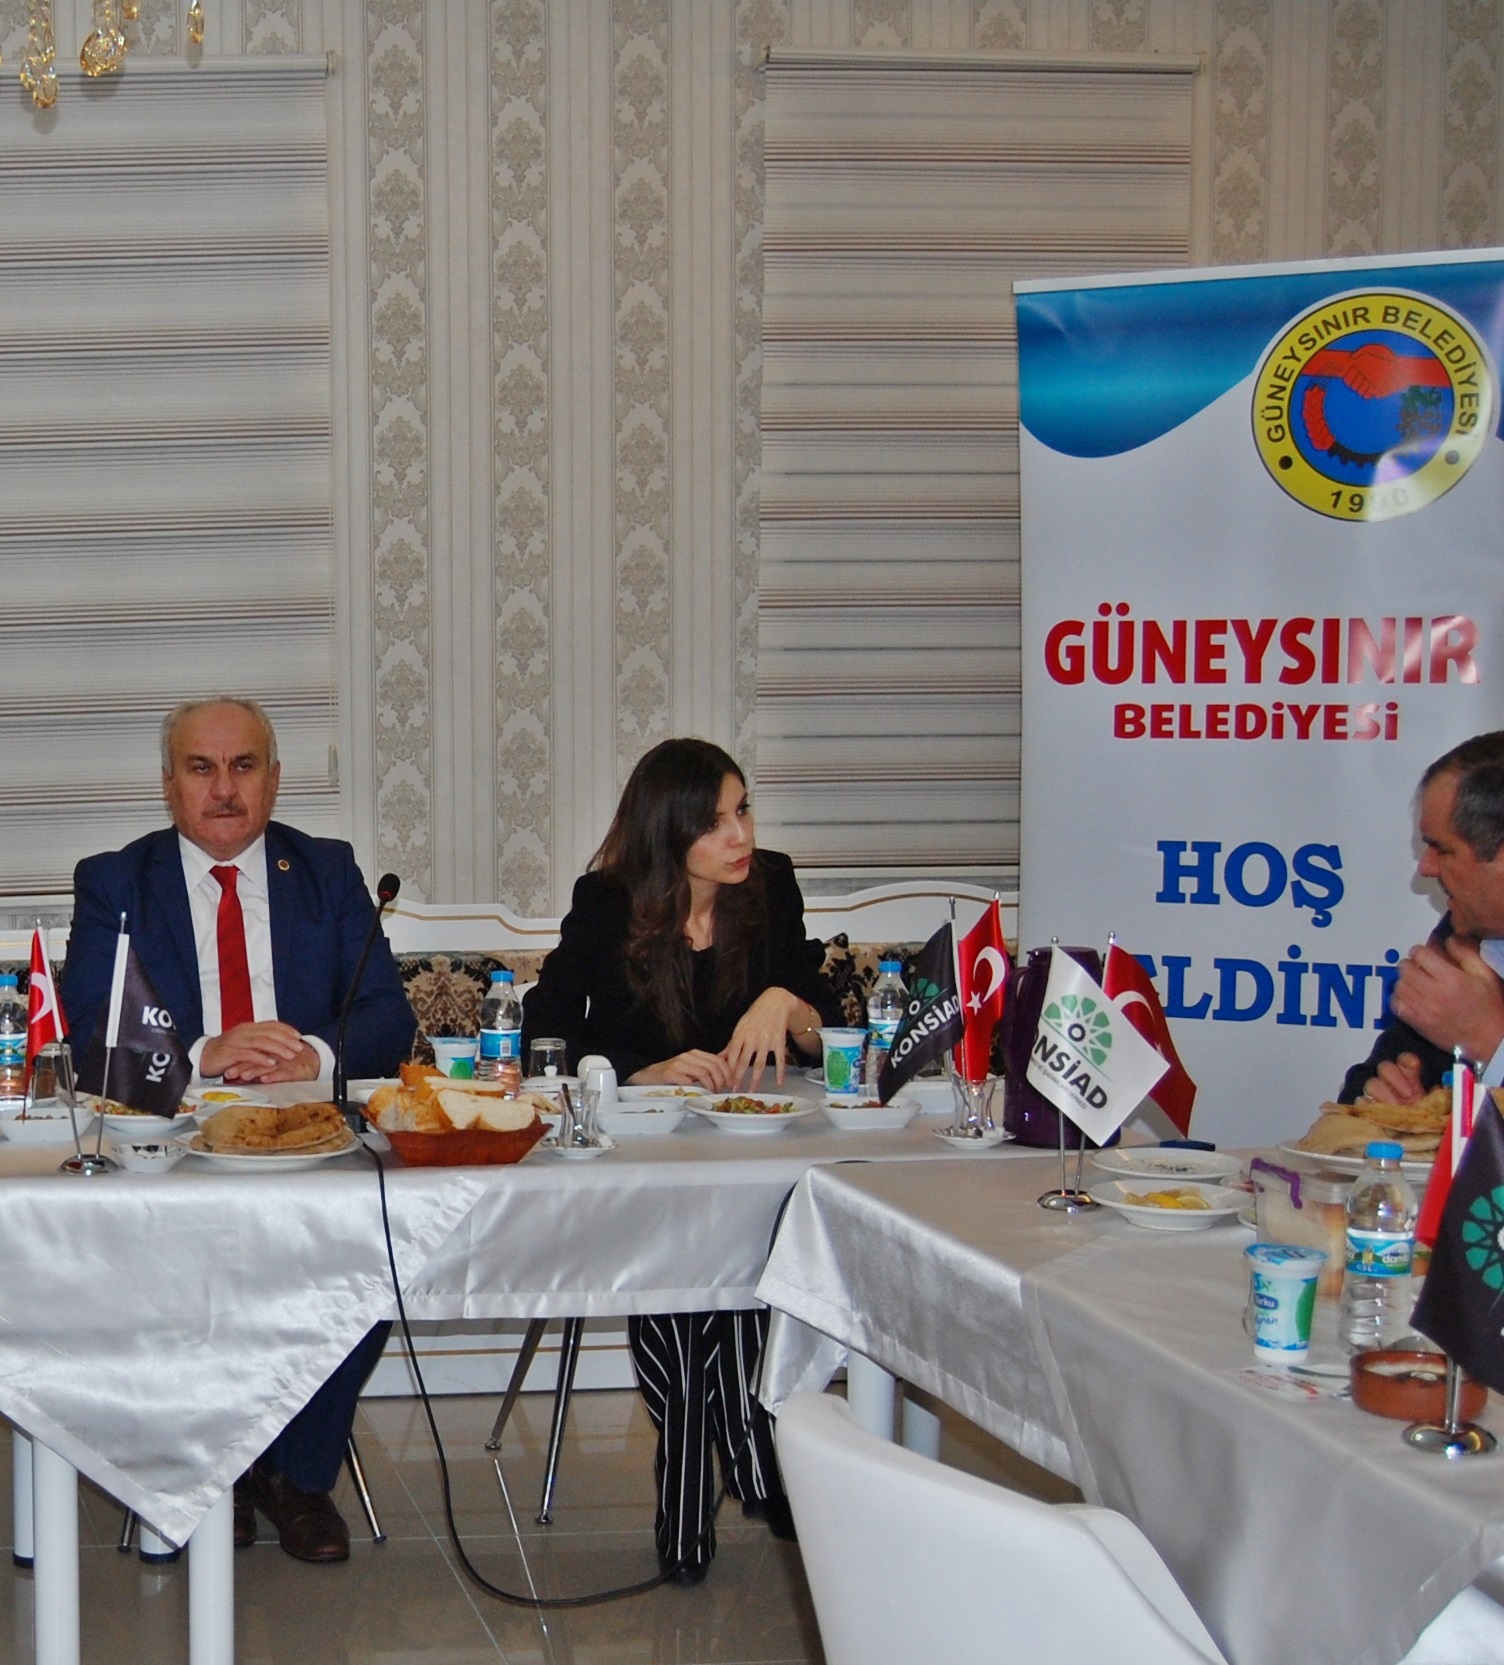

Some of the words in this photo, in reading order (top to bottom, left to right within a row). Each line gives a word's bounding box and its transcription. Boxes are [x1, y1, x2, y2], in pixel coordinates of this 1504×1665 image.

[1260, 305, 1371, 443] GÜNEYSINIR
[1044, 602, 1481, 686] GÜNEYSINIR
[1113, 701, 1399, 741] BELEDİYESİ
[1155, 840, 1345, 928] HOŞ
[1134, 944, 1400, 1031] LDİNİ
[1034, 1034, 1108, 1109] NSİAD
